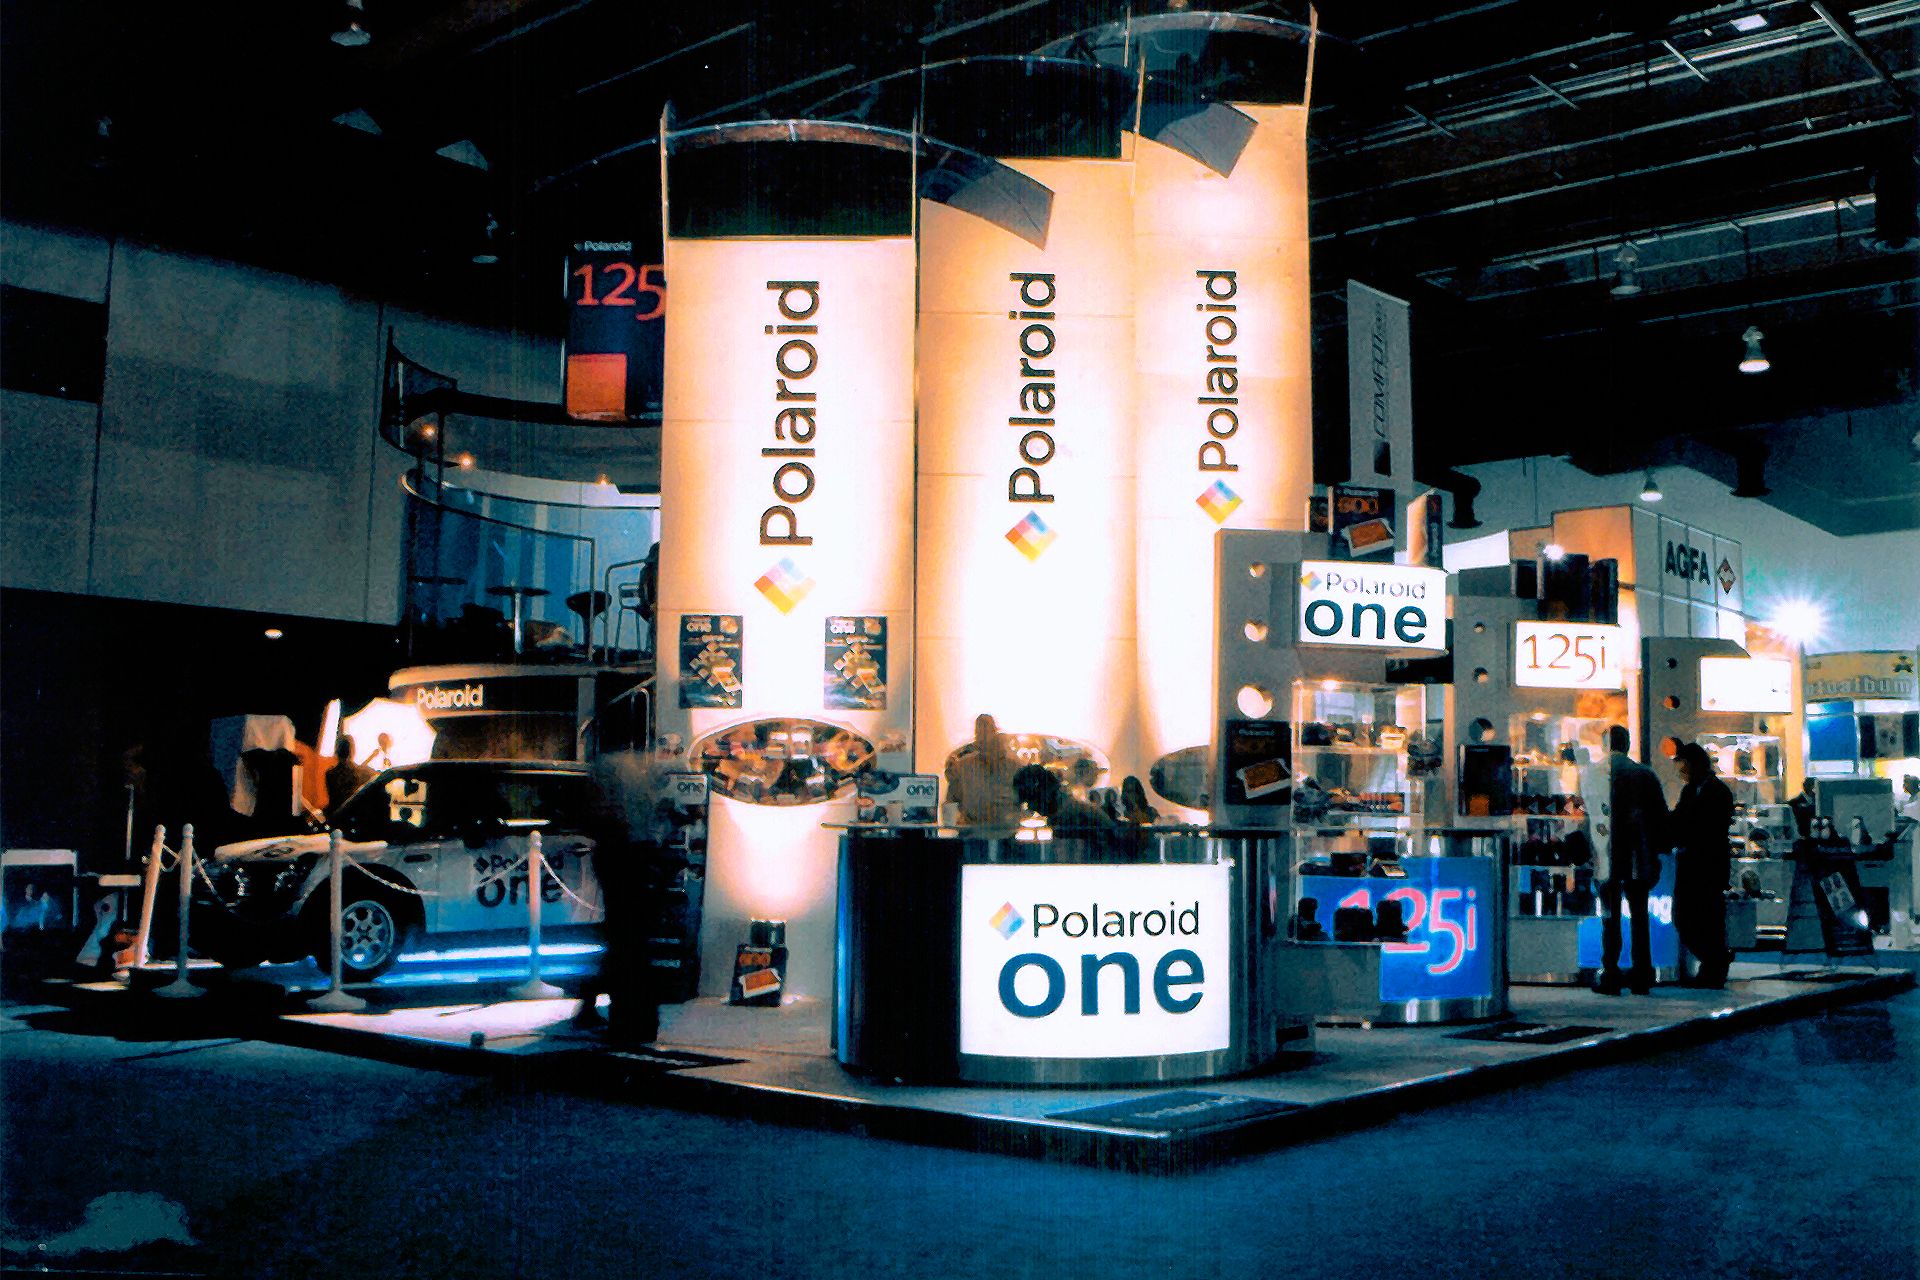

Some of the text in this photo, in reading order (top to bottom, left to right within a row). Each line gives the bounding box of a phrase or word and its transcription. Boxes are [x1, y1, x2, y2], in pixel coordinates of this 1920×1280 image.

[583, 240, 632, 253] Polaroid
[1008, 272, 1057, 504] Polaroid
[1195, 269, 1240, 473] Polaroid
[758, 280, 821, 546] Polaroid
[1326, 572, 1427, 599] Polaroid
[1664, 540, 1711, 586] AGFA
[1304, 599, 1428, 643] one
[1521, 634, 1607, 682] 125i
[416, 684, 484, 709] Polaroid
[1033, 901, 1200, 938] Polaroid
[998, 948, 1205, 1019] one
